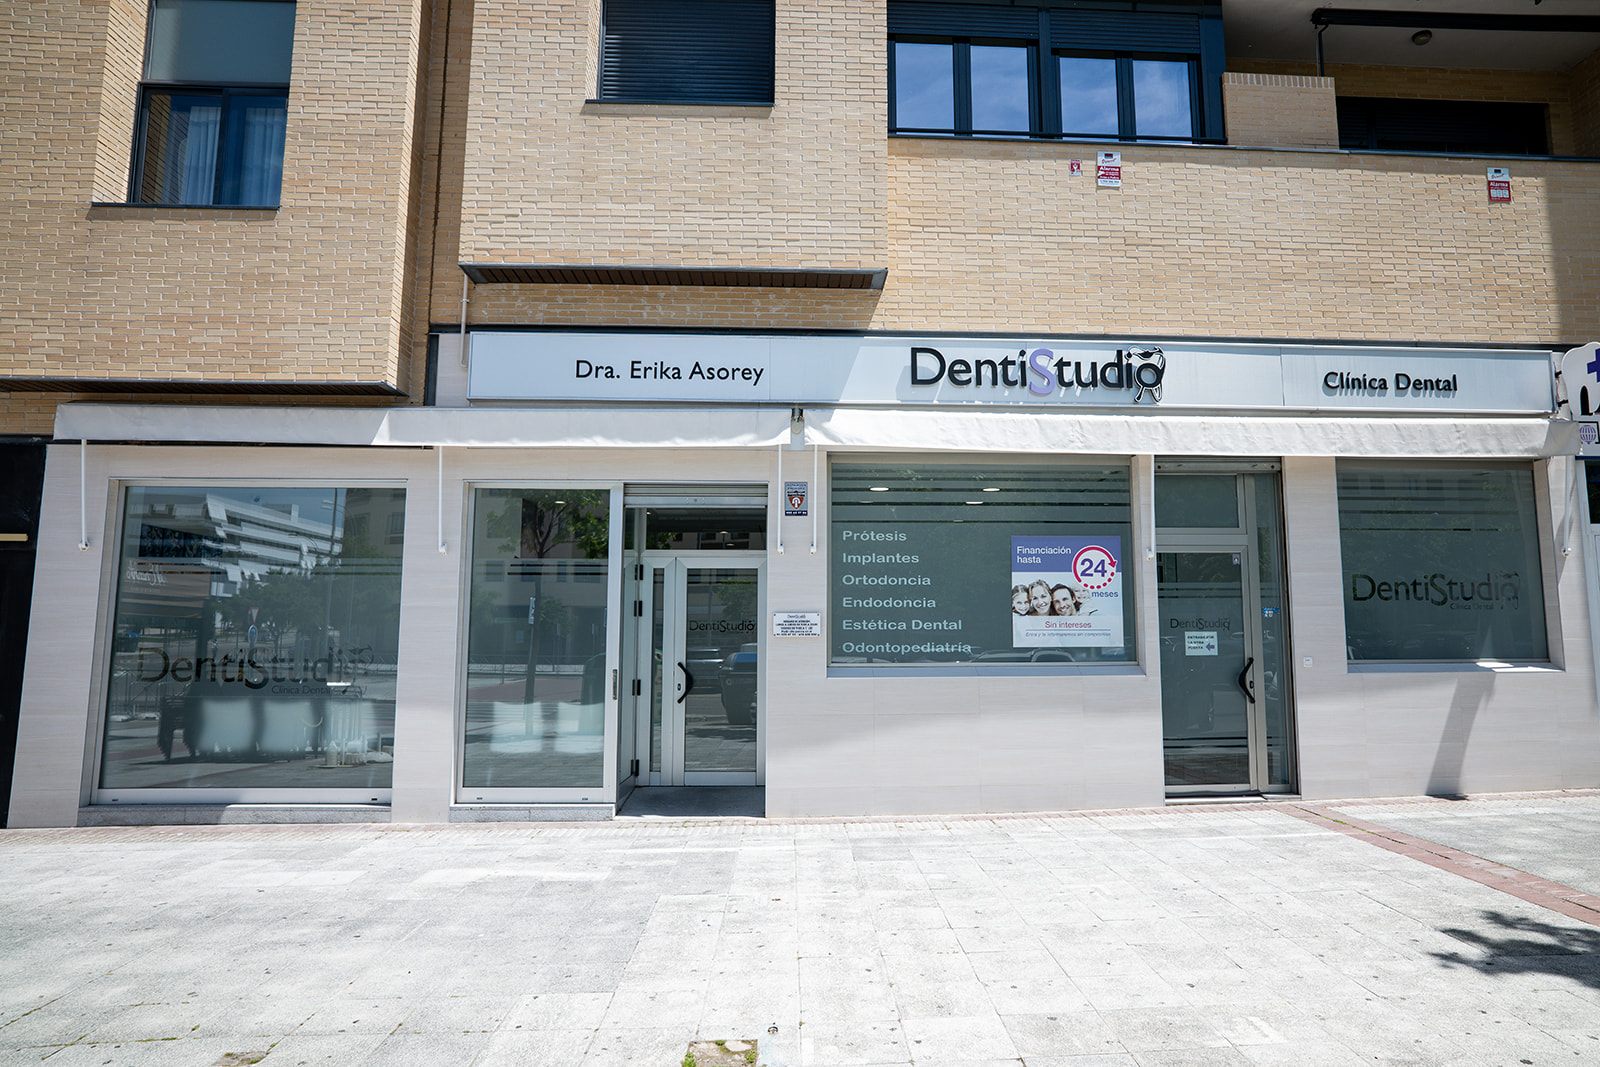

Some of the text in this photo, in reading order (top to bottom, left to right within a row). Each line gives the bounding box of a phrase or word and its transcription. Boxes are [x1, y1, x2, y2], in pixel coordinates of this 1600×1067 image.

[575, 359, 765, 386] Dra. Erika Asorey
[910, 346, 1165, 396] DentiStudio
[1323, 371, 1458, 392] Clínica Dental
[842, 530, 908, 541] Prótesis
[1016, 545, 1072, 555] Financiación
[842, 552, 920, 565] Implantes
[1016, 555, 1042, 564] hasta
[1080, 558, 1107, 577] 24
[842, 574, 932, 586] Ortodoncia
[1351, 572, 1519, 606] DentiStudio
[842, 597, 937, 608] Endodoncia
[842, 619, 962, 630] Estética Dental
[1045, 621, 1092, 629] Sin intereses
[842, 641, 972, 655] Odontopediatría
